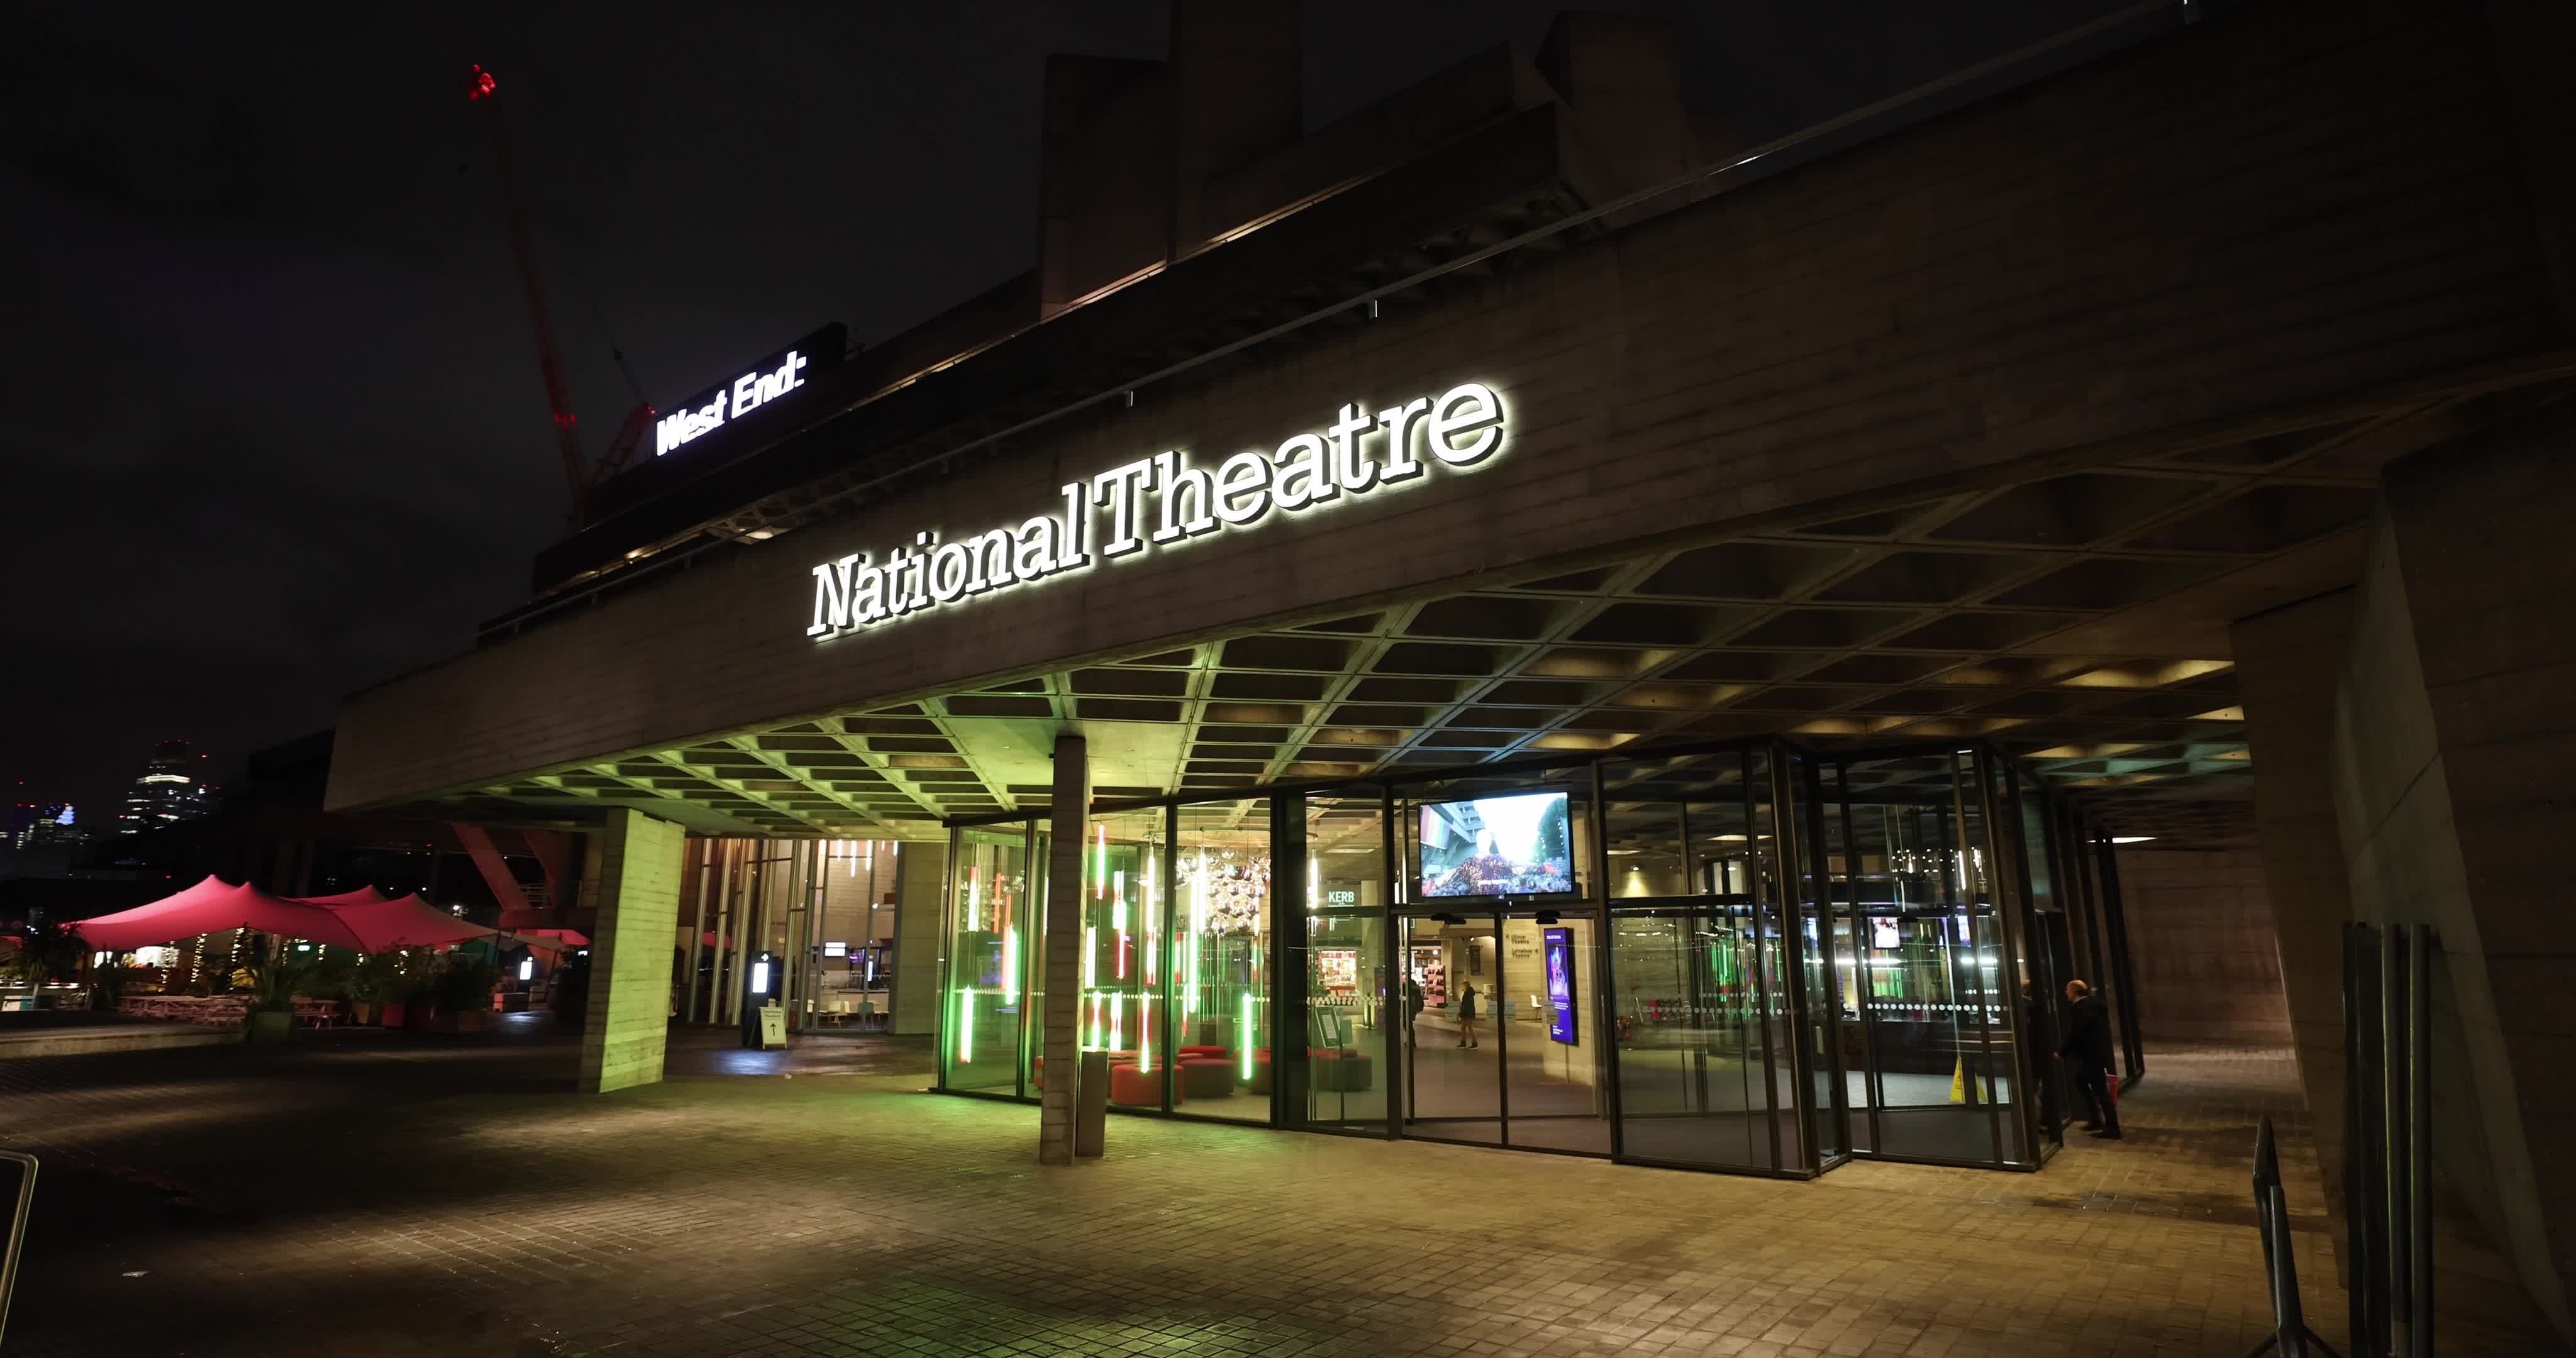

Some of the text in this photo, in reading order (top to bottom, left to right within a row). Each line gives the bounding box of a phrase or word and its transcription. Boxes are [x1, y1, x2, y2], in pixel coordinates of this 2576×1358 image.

[657, 350, 806, 456] West End:
[808, 382, 1504, 637] National Theatre
[1328, 891, 1355, 903] KERB
